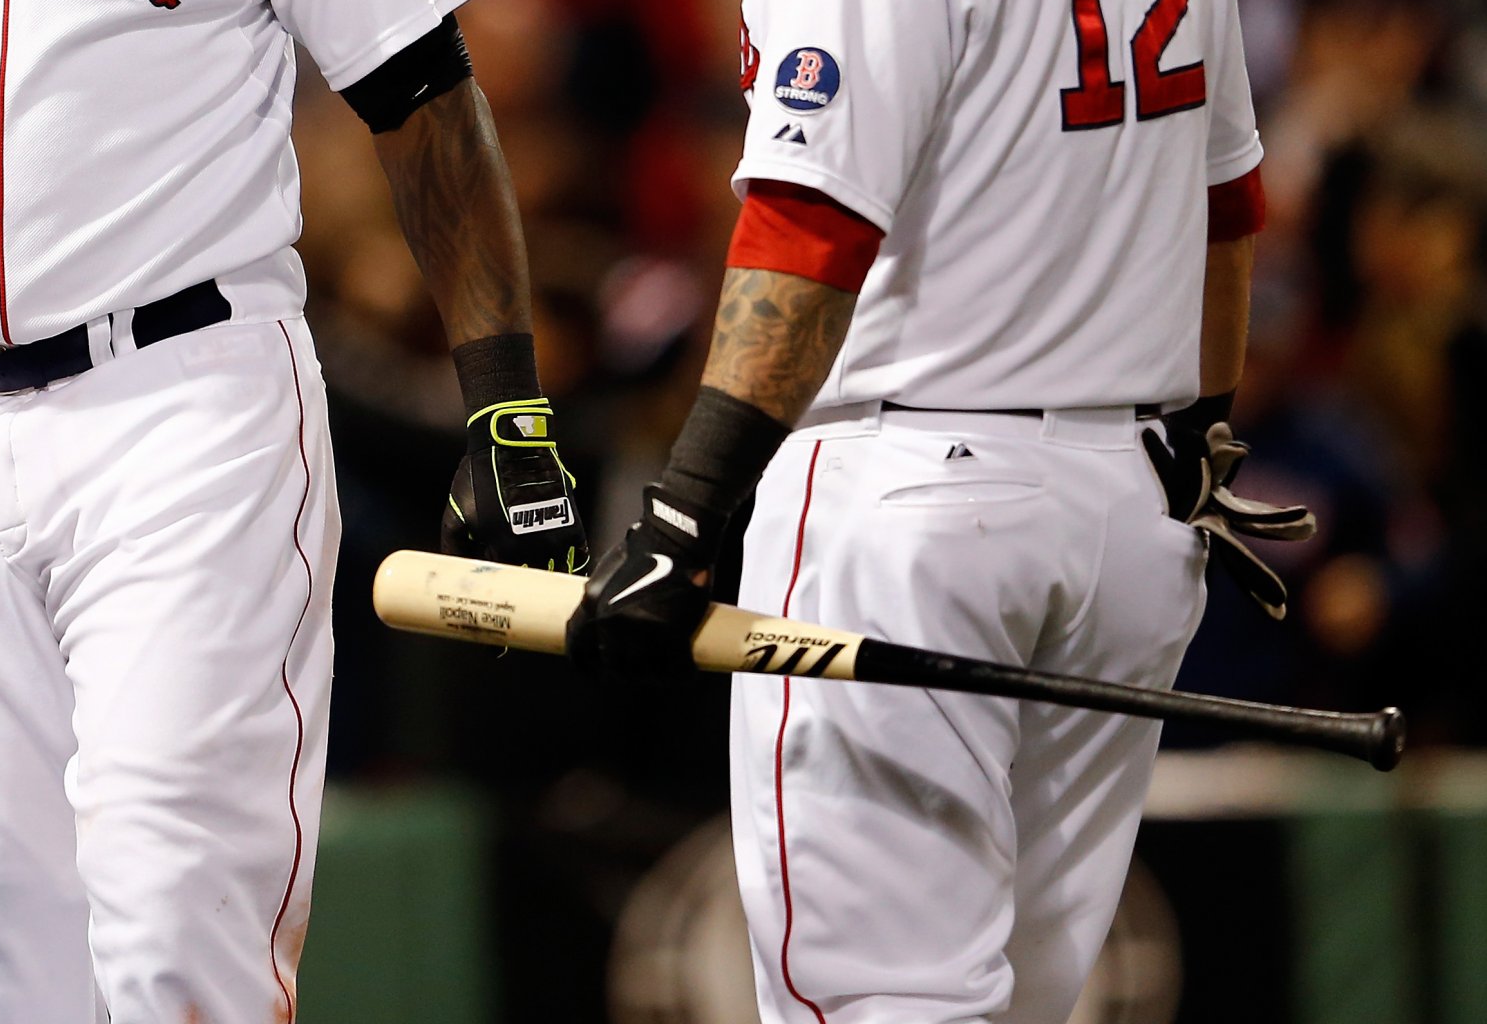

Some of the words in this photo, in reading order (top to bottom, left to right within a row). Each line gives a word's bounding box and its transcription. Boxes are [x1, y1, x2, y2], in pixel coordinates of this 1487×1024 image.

[790, 50, 825, 90] B
[775, 85, 830, 106] STRONG
[439, 606, 479, 626] Napoli
[480, 611, 511, 630] Mike
[744, 631, 832, 646] marucci
